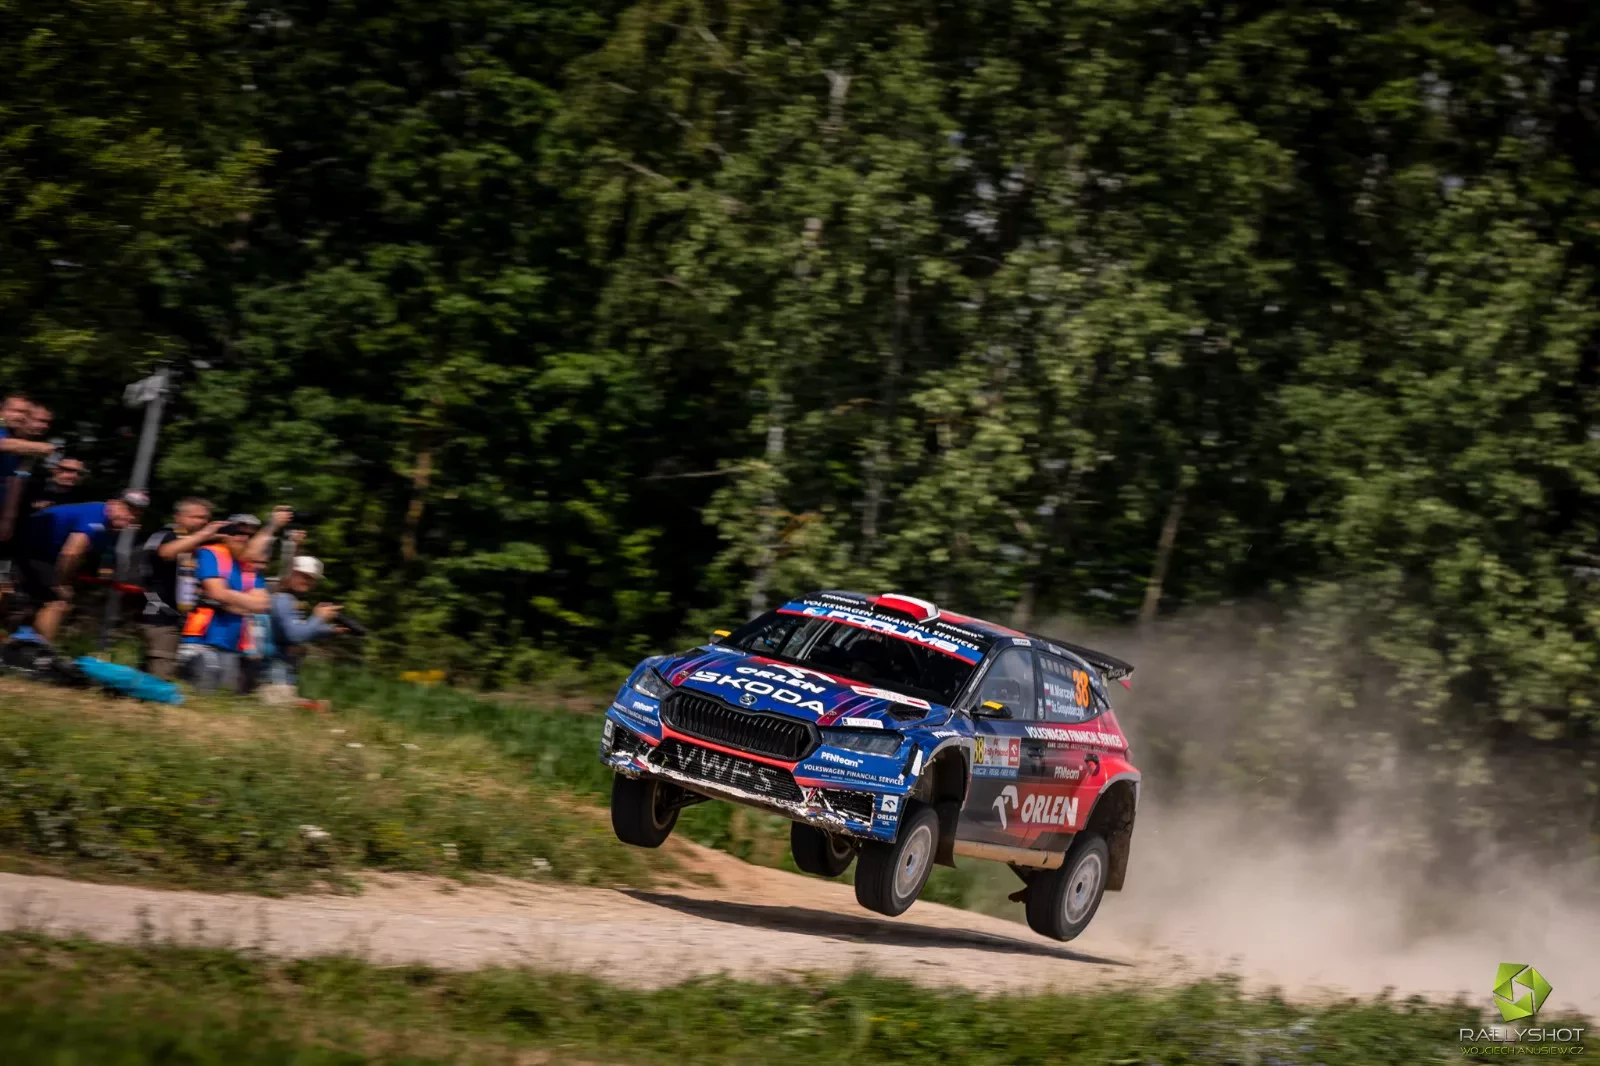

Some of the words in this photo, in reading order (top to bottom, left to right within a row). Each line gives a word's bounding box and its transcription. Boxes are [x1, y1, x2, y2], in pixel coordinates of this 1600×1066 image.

[803, 599, 873, 617] VOLKSWAGEN
[875, 613, 930, 634] FINANCIAL
[932, 630, 980, 651] SERVICES
[736, 666, 826, 694] ORLEN
[1072, 669, 1090, 709] 38
[1024, 725, 1068, 741] VOLKSWAGEN
[1067, 729, 1098, 745] FINANCIAL
[1097, 732, 1123, 748] SERVICES
[821, 751, 859, 768] PFNteam
[803, 763, 846, 776] VOLKSWAGEN
[846, 770, 878, 781] FINANCIAL
[878, 776, 905, 786] SERVICES
[1053, 765, 1080, 780] PFNteam
[877, 813, 898, 822] ORLEN
[1021, 793, 1079, 827] ORLEN
